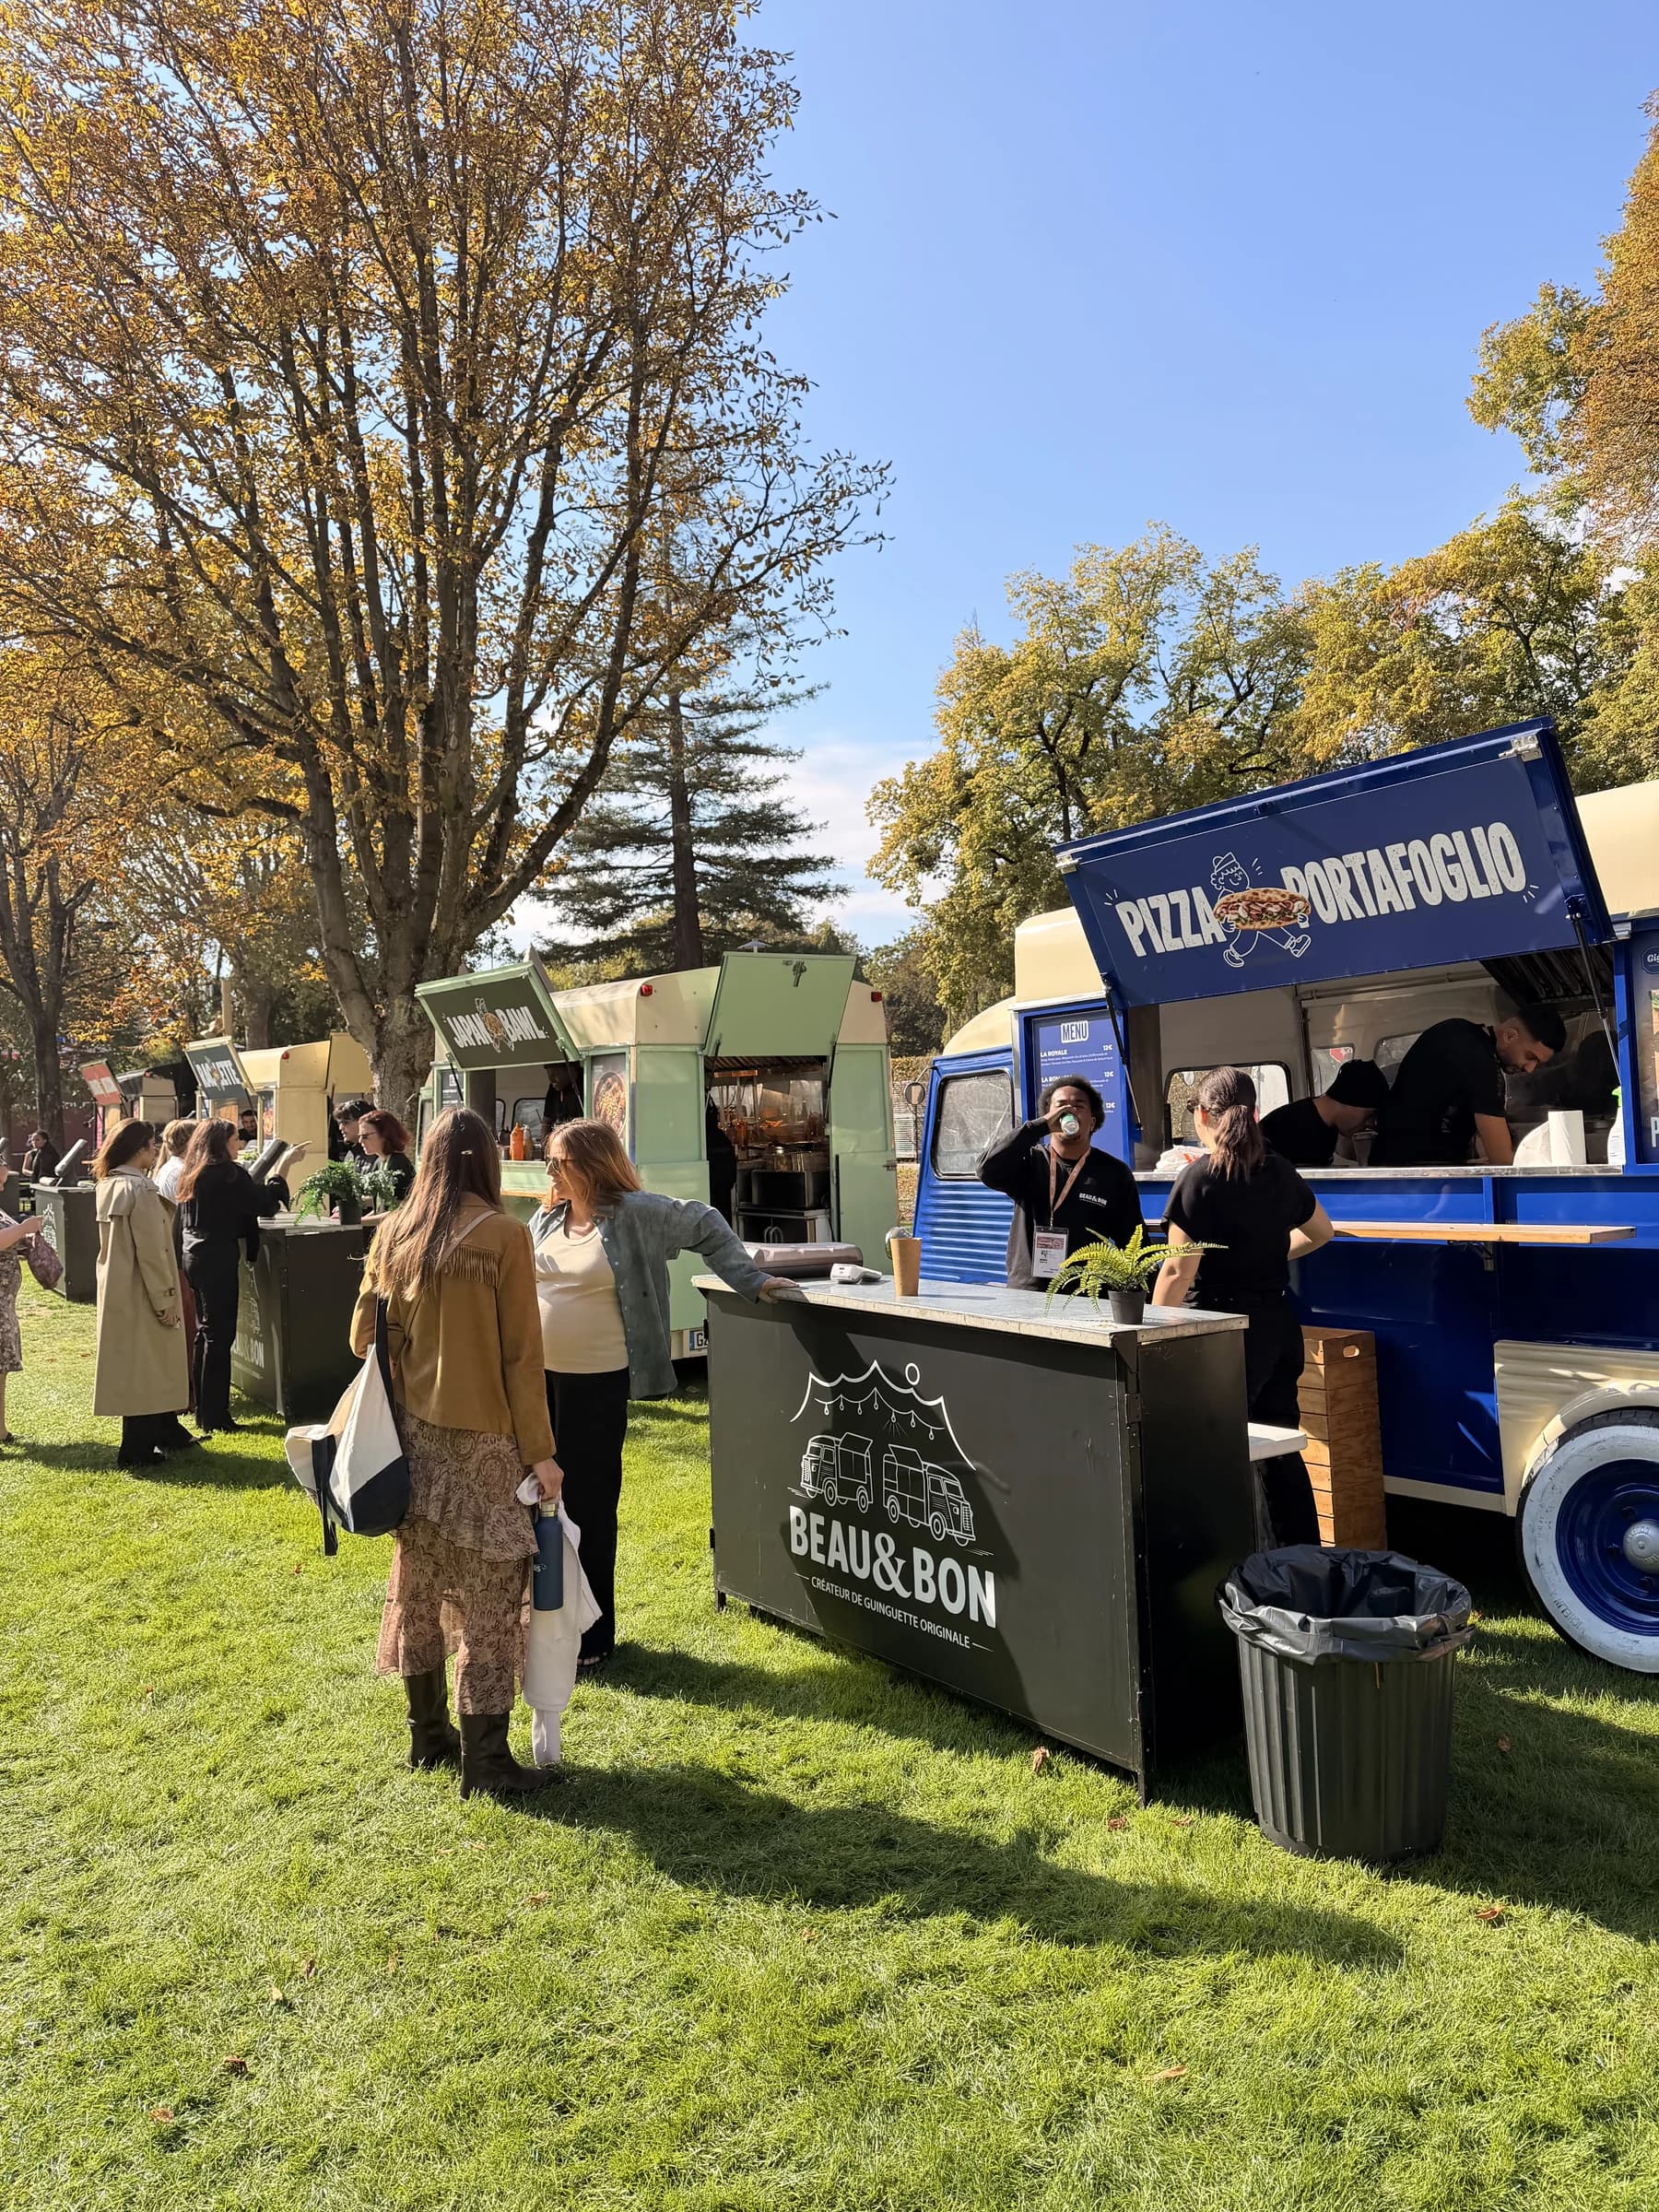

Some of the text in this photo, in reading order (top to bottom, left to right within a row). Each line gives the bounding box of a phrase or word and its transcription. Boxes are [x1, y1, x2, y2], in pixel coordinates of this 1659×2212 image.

[1114, 821, 1526, 958] PIZZA PORTAFOGLIO
[446, 1006, 547, 1048] JAPAN BAWL
[1062, 1021, 1088, 1041] MENU
[790, 1505, 996, 1629] BEAU&BON
[811, 1576, 971, 1649] CRÉATEUR DE GUINGUETTE ORIGINALE
